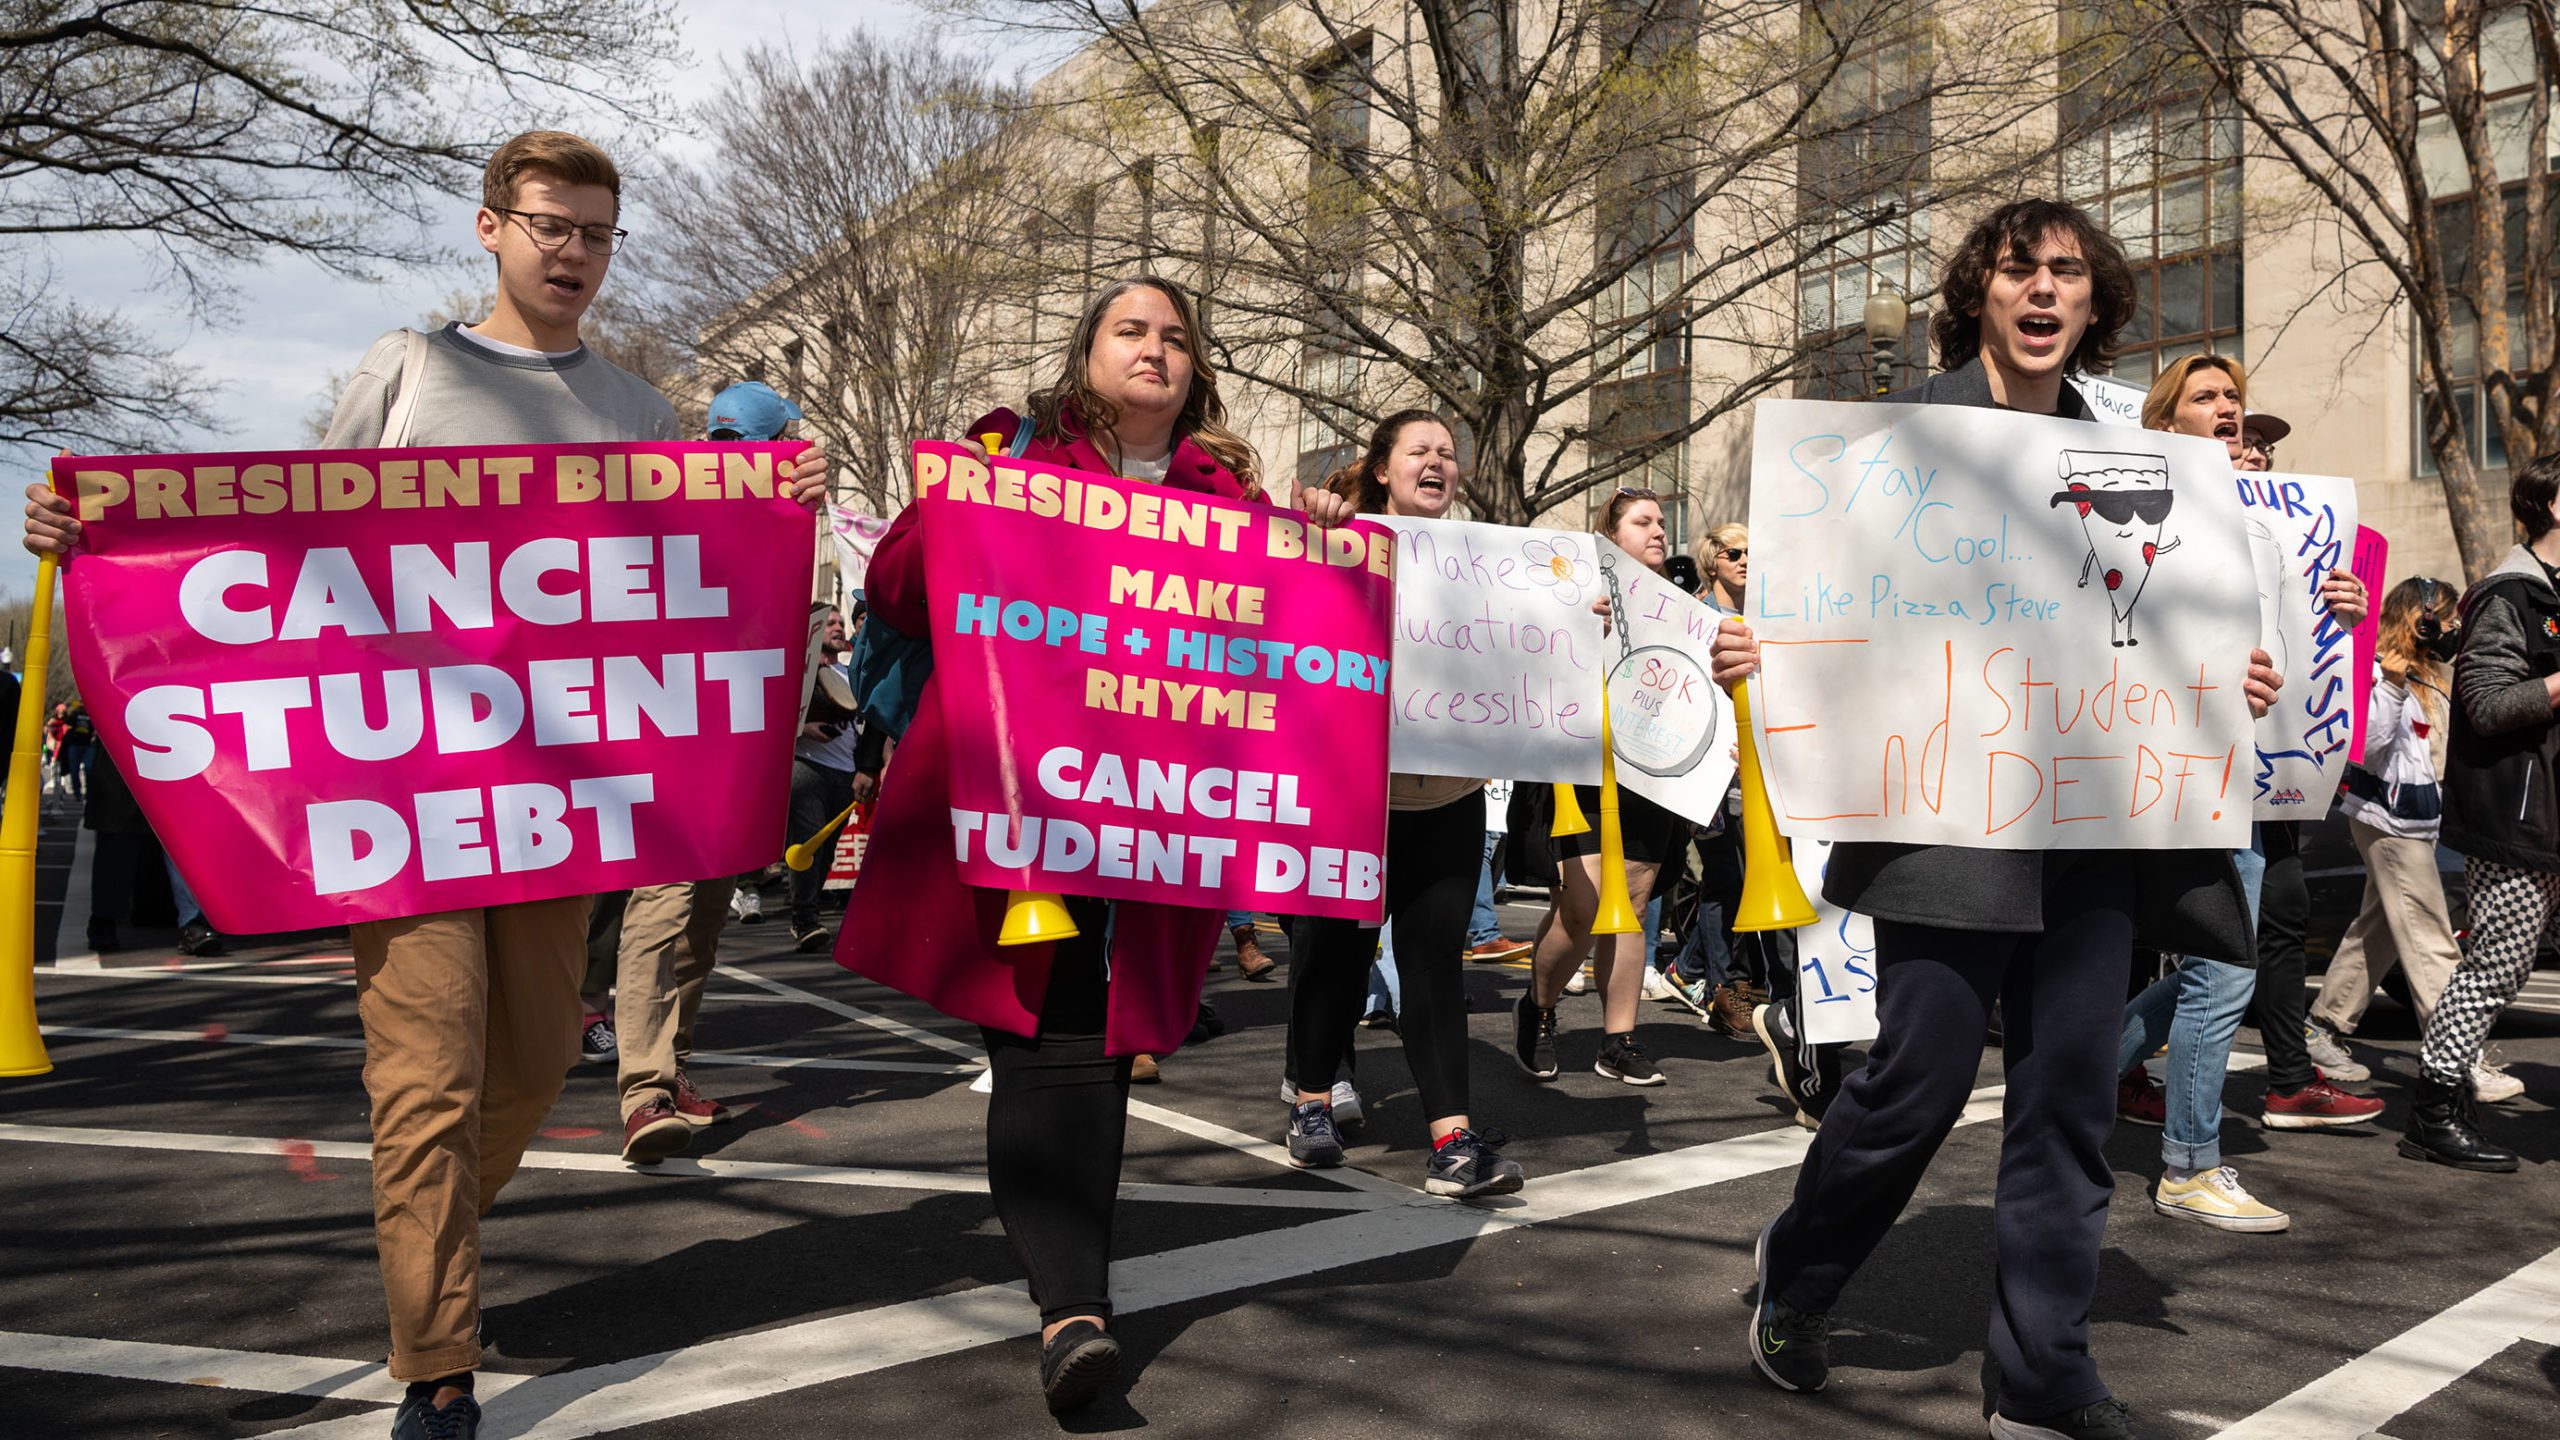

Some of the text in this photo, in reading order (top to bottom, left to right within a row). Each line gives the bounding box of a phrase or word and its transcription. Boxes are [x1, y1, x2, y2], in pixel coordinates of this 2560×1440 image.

[2094, 383, 2140, 420] Have
[76, 452, 796, 521] PRESIDENT BIDEN:
[916, 453, 1396, 582] PRESIDENT BIDE
[1777, 433, 1937, 540] Stay
[2236, 477, 2313, 519] OUR
[1396, 530, 1531, 590] Make
[1913, 501, 2033, 565] Cool...
[179, 534, 729, 646] CANCEL
[1109, 564, 1265, 626] MAKE
[1642, 592, 1677, 623] I
[1687, 610, 1719, 647] WE
[1759, 572, 2062, 626] Like Pizza Steve
[955, 592, 1392, 696] HOPE + HISTORY
[1394, 592, 1588, 672] ducation
[2297, 503, 2350, 767] PROMISE!
[124, 648, 786, 782] STUDENT
[1084, 668, 1277, 732] RHYME
[1612, 703, 1685, 754] INTEREST
[1632, 689, 1663, 718] PLUS
[1758, 639, 1952, 821] End
[1980, 647, 2219, 738] Student
[1037, 746, 1311, 827] CANCEL
[1985, 743, 2236, 835] DEBT!
[305, 772, 655, 896] DEBT
[950, 807, 1237, 889] TUDENT
[1254, 842, 1386, 902] DEB
